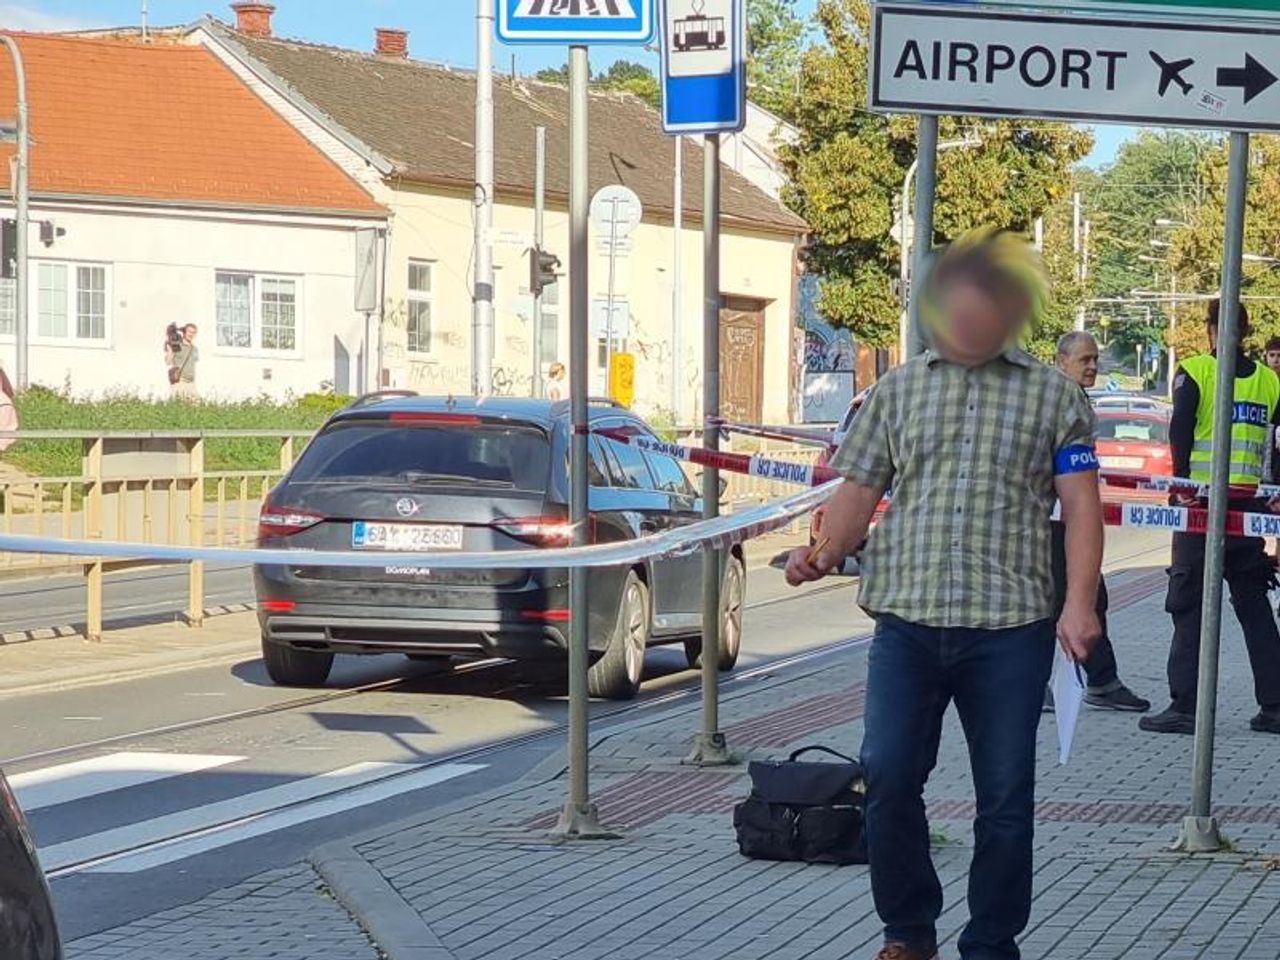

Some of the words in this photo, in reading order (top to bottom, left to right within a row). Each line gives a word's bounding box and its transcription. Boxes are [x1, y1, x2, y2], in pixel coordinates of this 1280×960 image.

[893, 40, 1128, 91] AIRPORT
[772, 460, 808, 483] POLICIE
[1130, 506, 1144, 527] ČR
[1145, 507, 1181, 526] POLICIE
